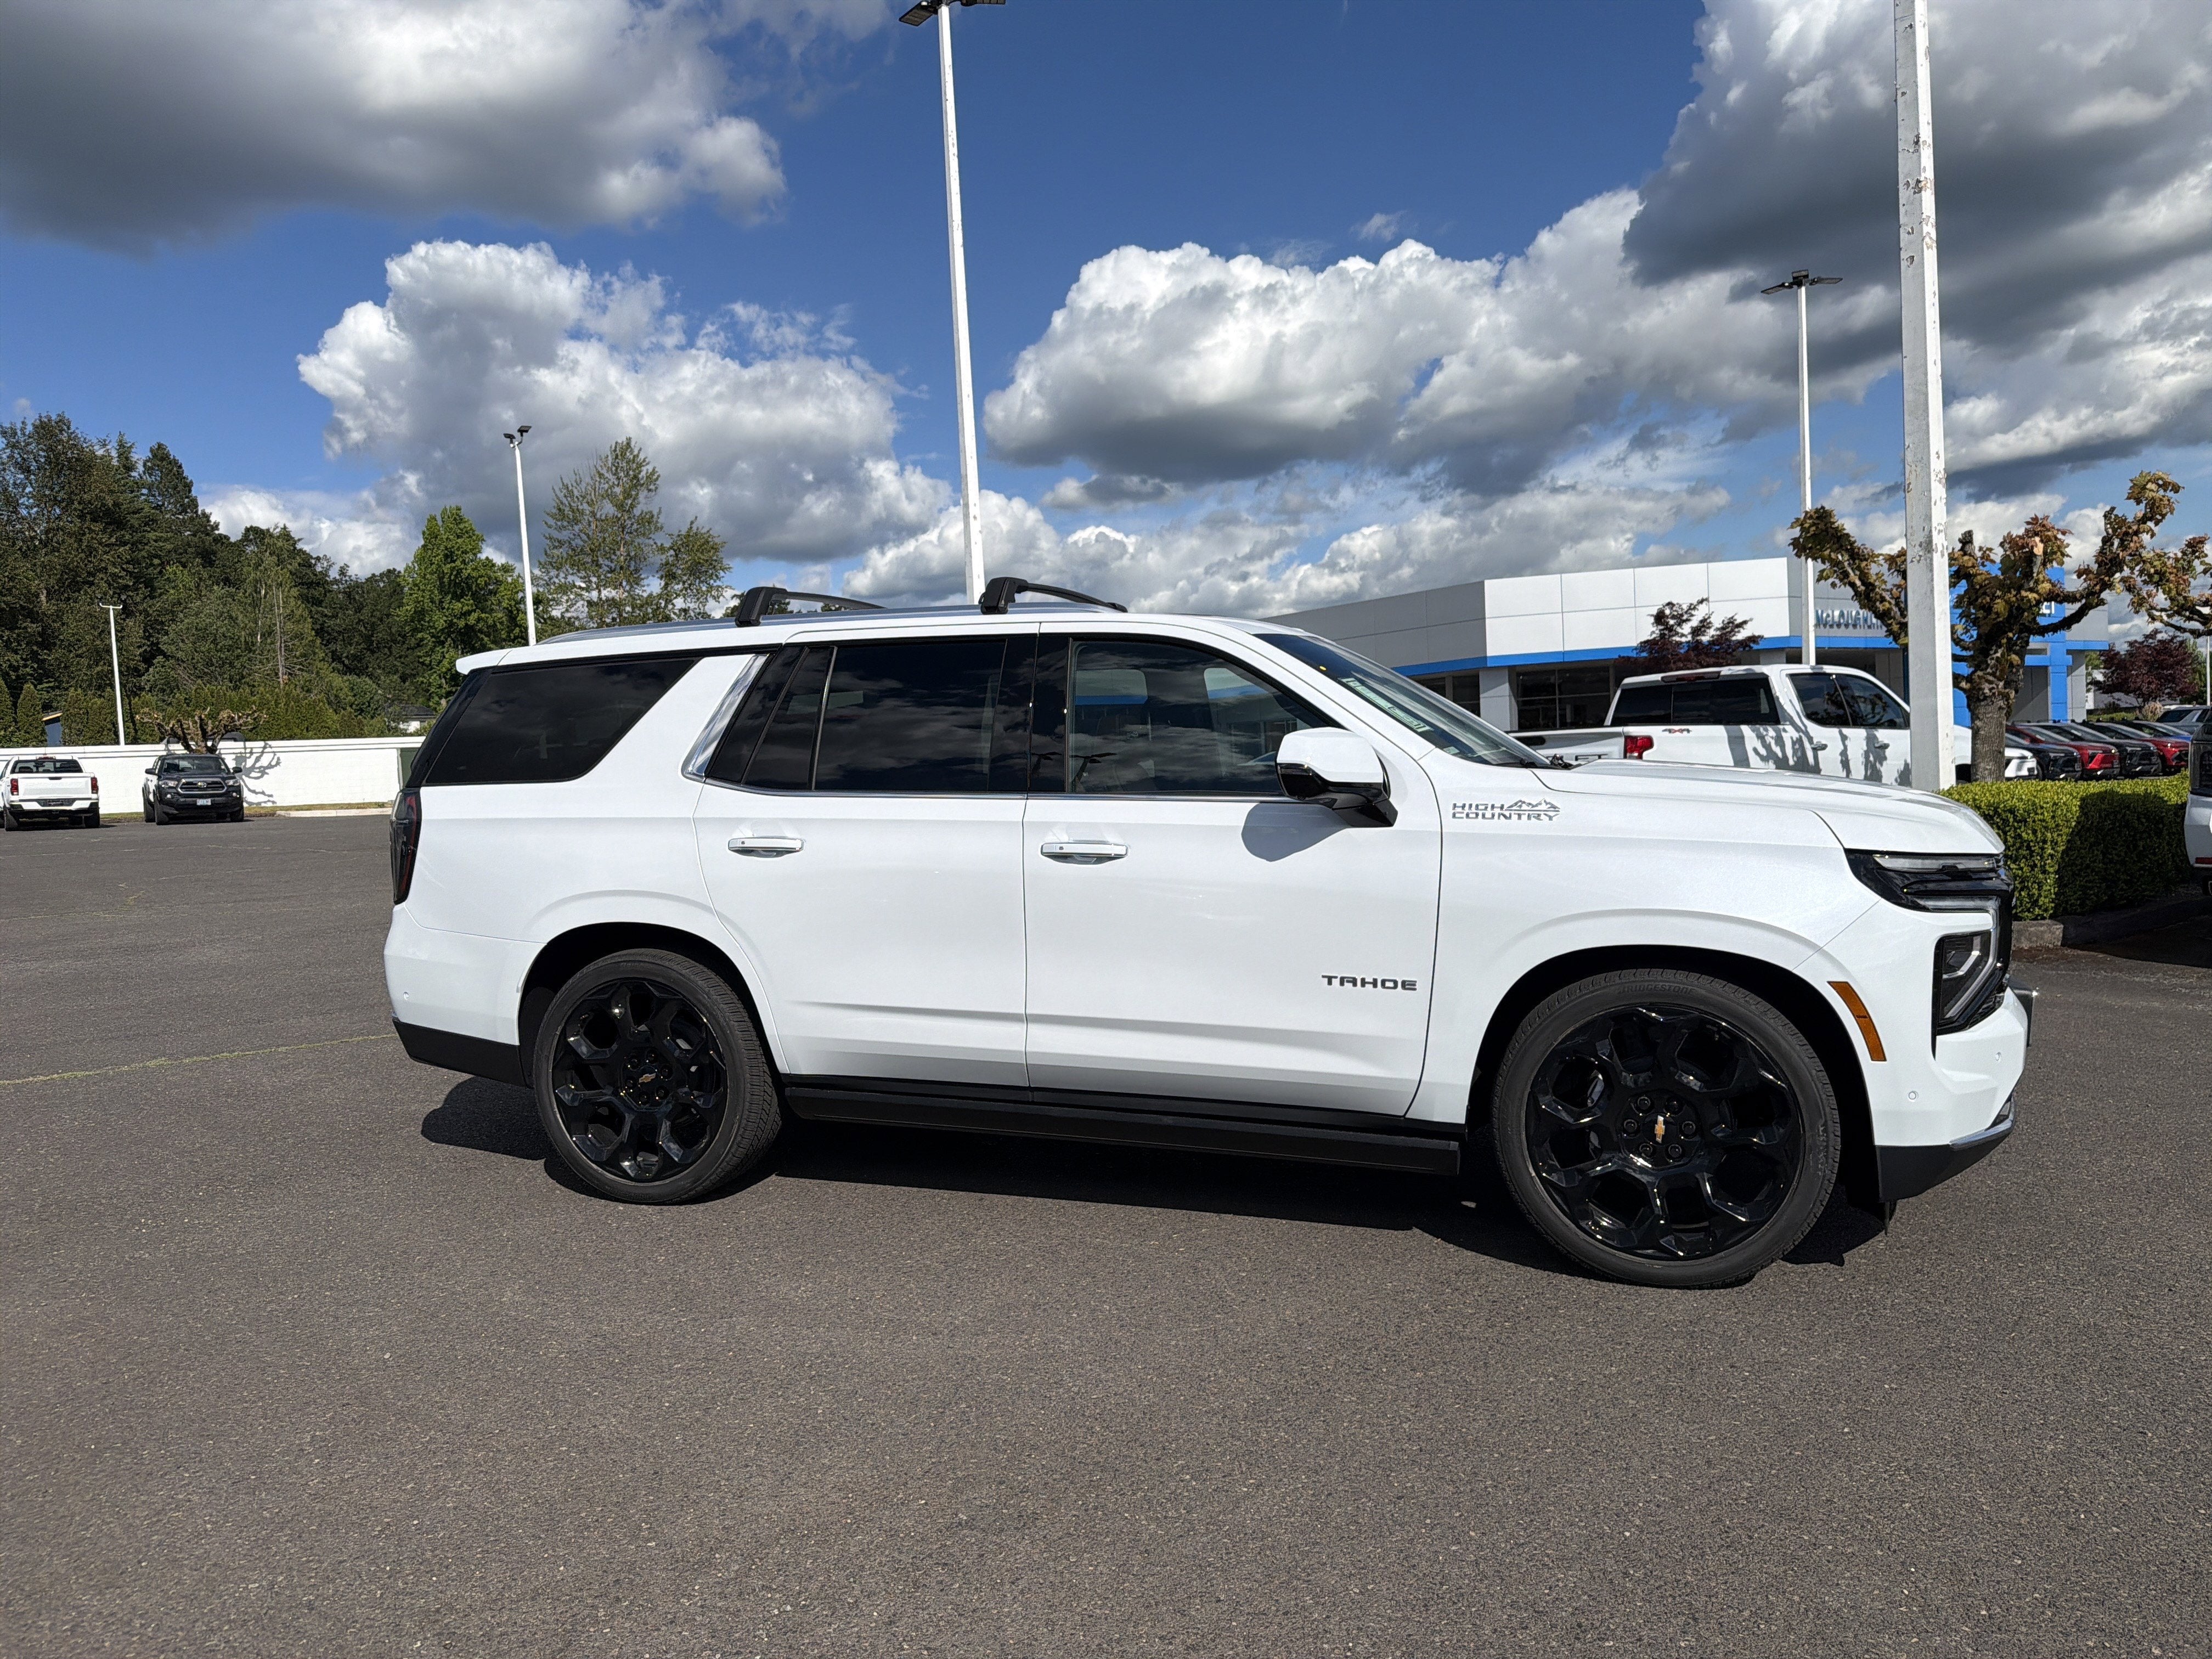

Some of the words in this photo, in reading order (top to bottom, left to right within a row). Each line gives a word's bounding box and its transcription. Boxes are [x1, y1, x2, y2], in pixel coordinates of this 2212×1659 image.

[1815, 610, 1883, 625] McLOUGHL
[1452, 803, 1504, 811] HIGH
[1452, 811, 1560, 821] COUNTRY
[1322, 975, 1417, 991] TAHOE
